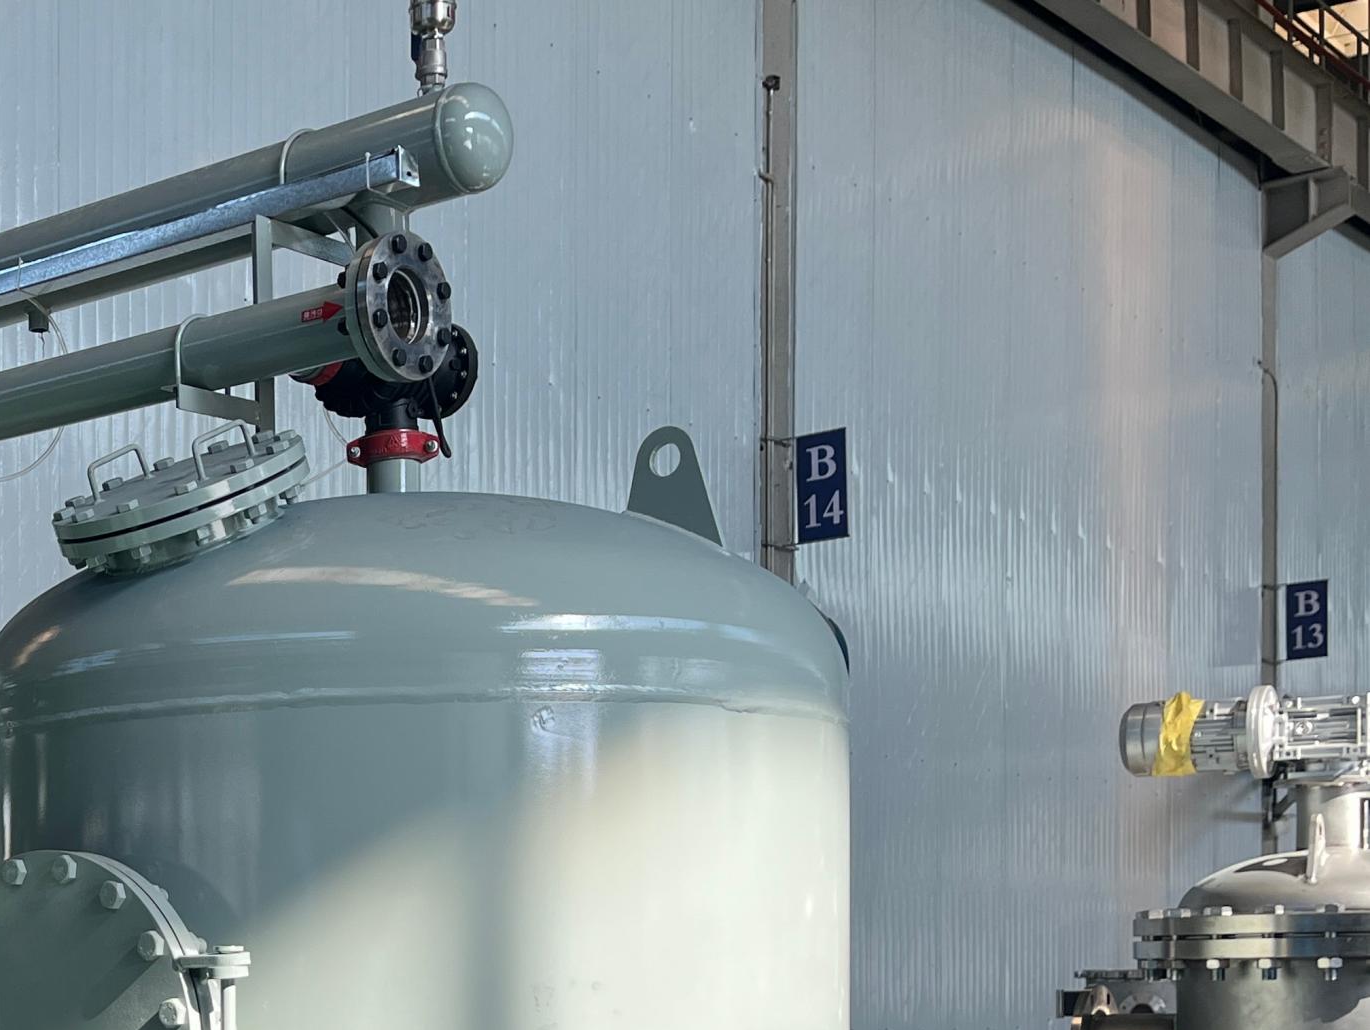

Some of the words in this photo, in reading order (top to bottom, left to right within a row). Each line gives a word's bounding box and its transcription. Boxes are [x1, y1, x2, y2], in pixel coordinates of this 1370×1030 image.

[806, 444, 837, 482] B
[804, 489, 844, 529] 14
[1294, 590, 1320, 617] B
[1291, 623, 1324, 651] 13
